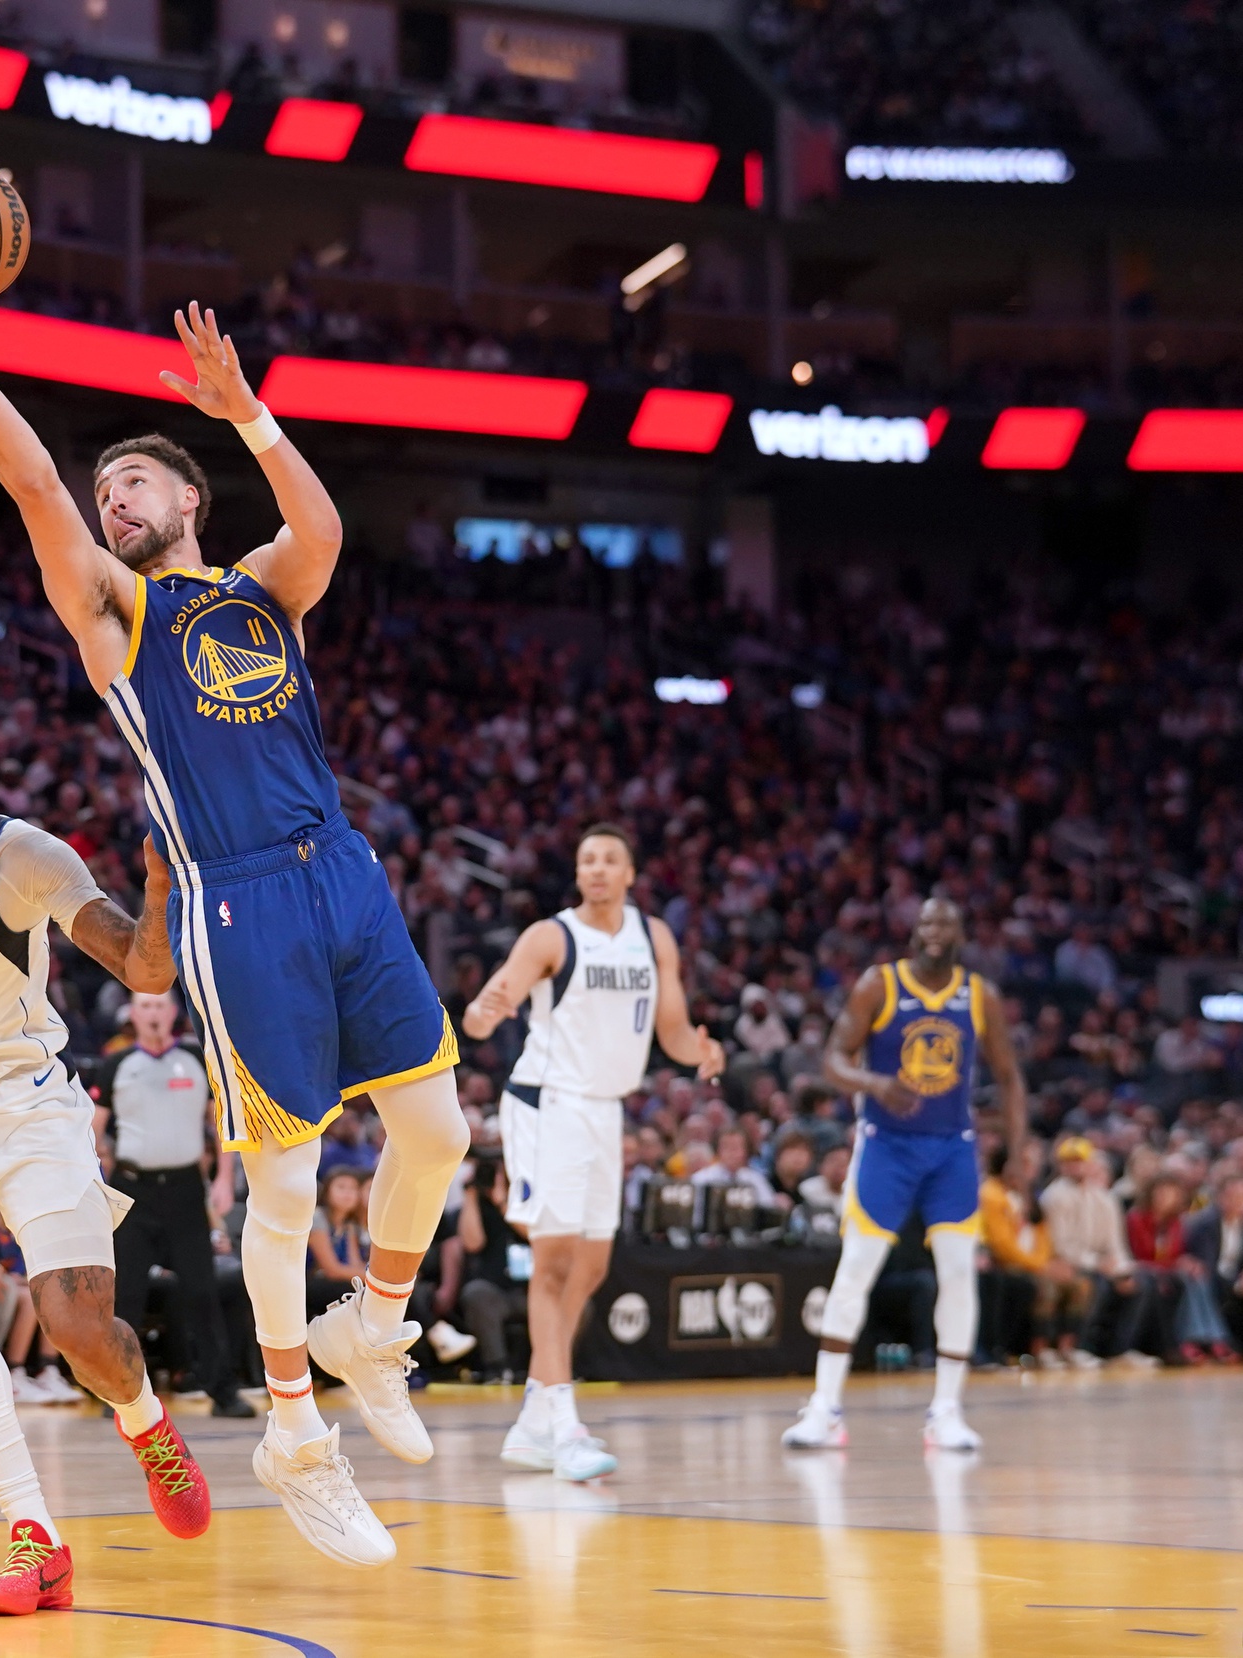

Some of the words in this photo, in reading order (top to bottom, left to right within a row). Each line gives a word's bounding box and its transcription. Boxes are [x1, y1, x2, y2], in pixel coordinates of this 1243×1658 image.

[44, 71, 212, 144] verizon
[749, 404, 929, 463] verizon
[170, 587, 221, 635] GOLDEN
[246, 617, 267, 646] 11
[196, 672, 300, 724] WARRIORS
[585, 965, 651, 990] DALLAS
[634, 997, 649, 1034] 0
